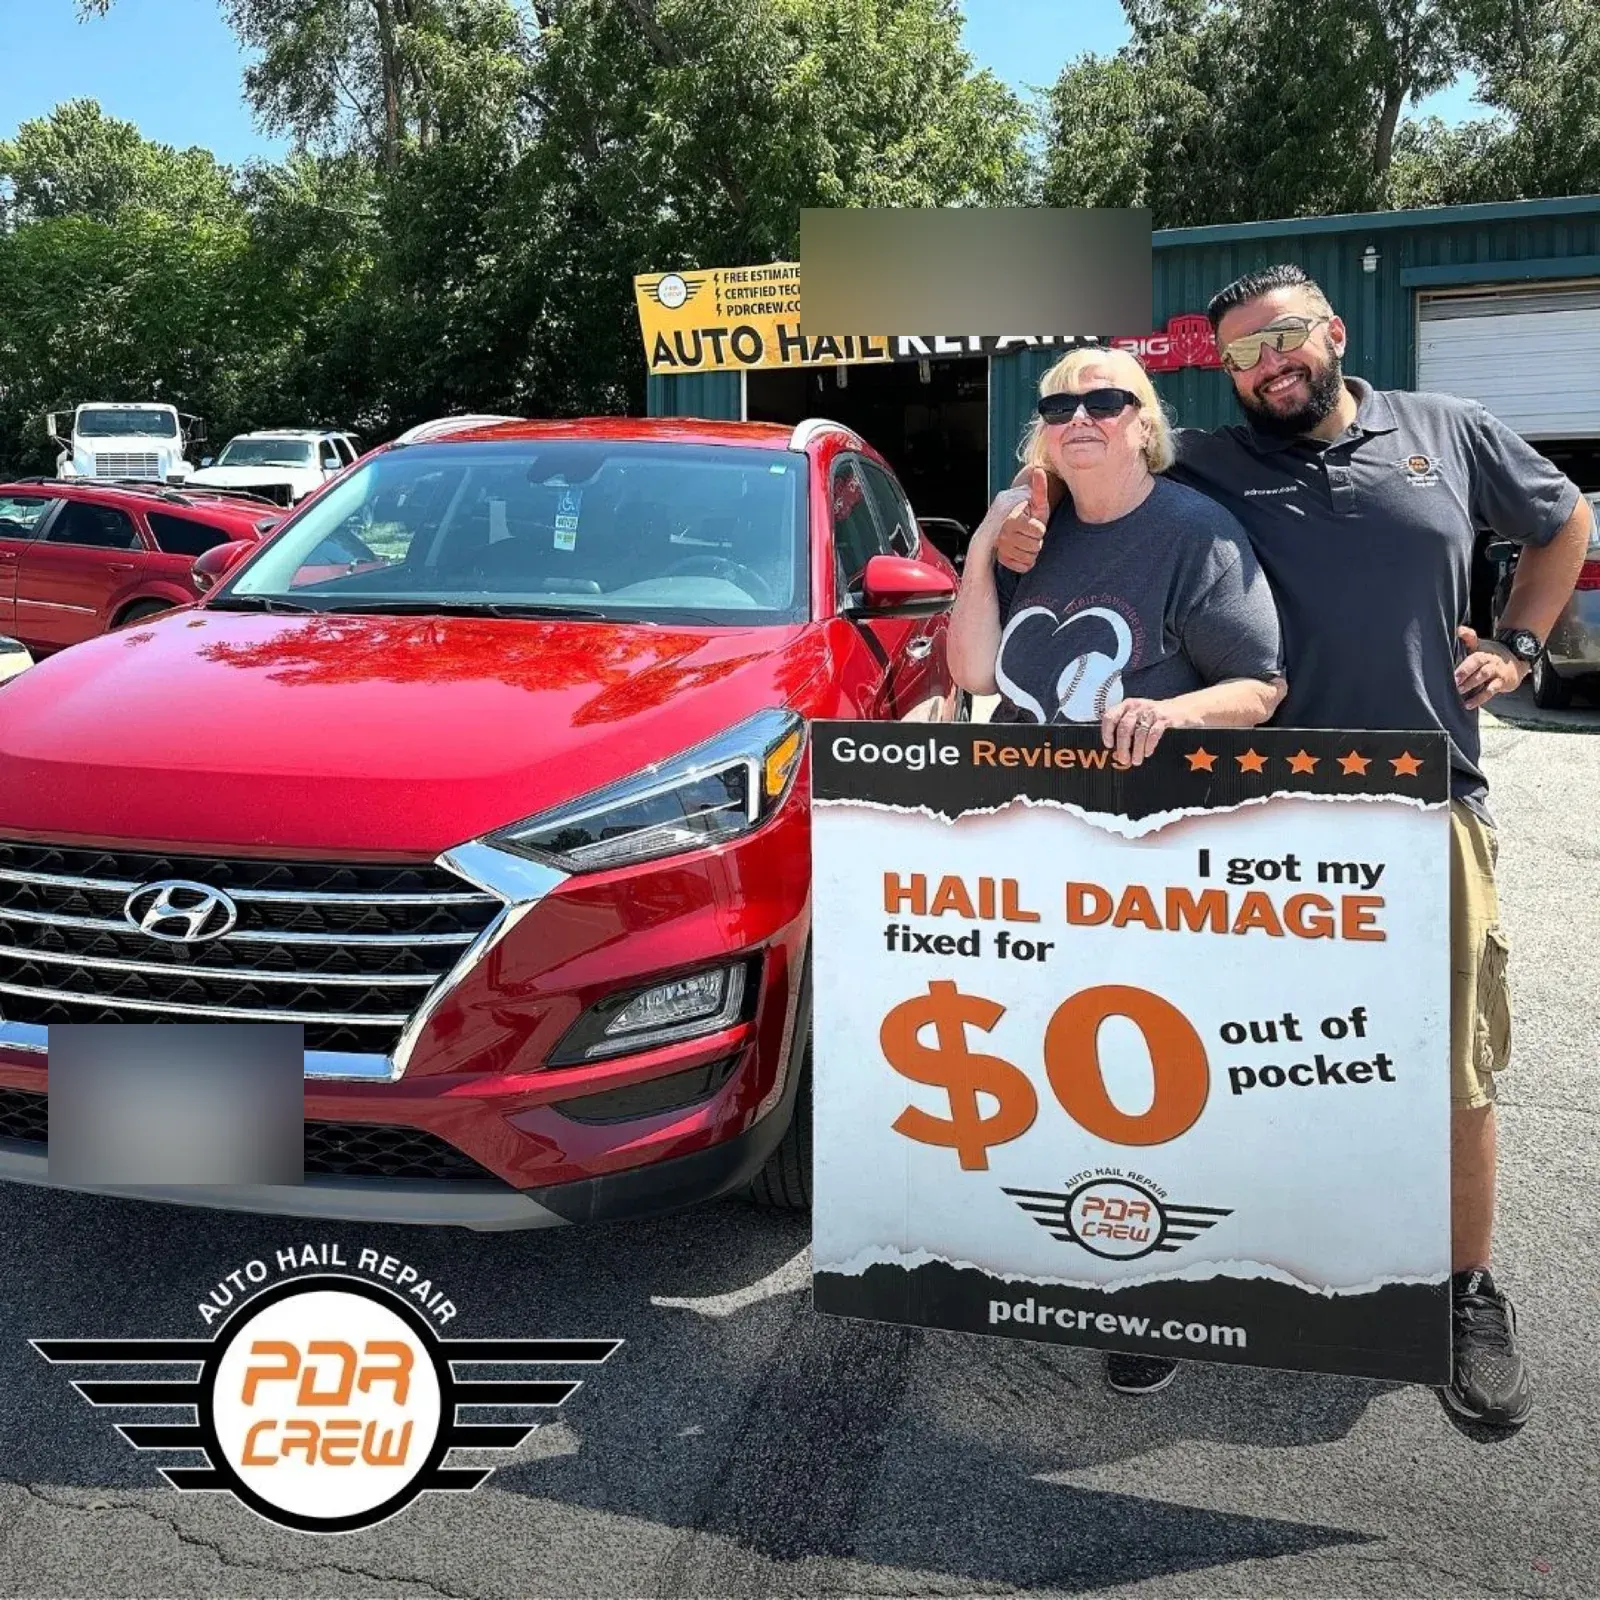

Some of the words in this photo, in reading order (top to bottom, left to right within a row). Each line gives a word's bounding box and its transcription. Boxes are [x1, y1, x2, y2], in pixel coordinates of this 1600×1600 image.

[724, 271, 749, 284] FREE
[724, 285, 777, 300] CERTIFIED
[652, 325, 764, 368] AUTO
[776, 323, 885, 362] HAIL
[831, 736, 961, 771] Google
[972, 740, 1132, 770] Reviews
[1198, 848, 1210, 878] I
[1227, 853, 1301, 886] got
[1317, 859, 1385, 890] my
[883, 872, 1041, 922] HAIL
[1065, 881, 1387, 942] DAMAGE
[884, 923, 981, 958] fixed
[994, 930, 1055, 962] for
[1219, 1011, 1303, 1045] out
[1320, 1006, 1368, 1041] of
[879, 980, 1211, 1171] $0
[1227, 1052, 1396, 1095] pocket
[1064, 1169, 1093, 1190] AUTO
[1094, 1166, 1124, 1178] HAIL
[1126, 1170, 1169, 1199] REPAIR
[1081, 1196, 1151, 1223] PDR
[1081, 1221, 1151, 1243] CREW
[988, 1297, 1248, 1349] pdrcrew.com
